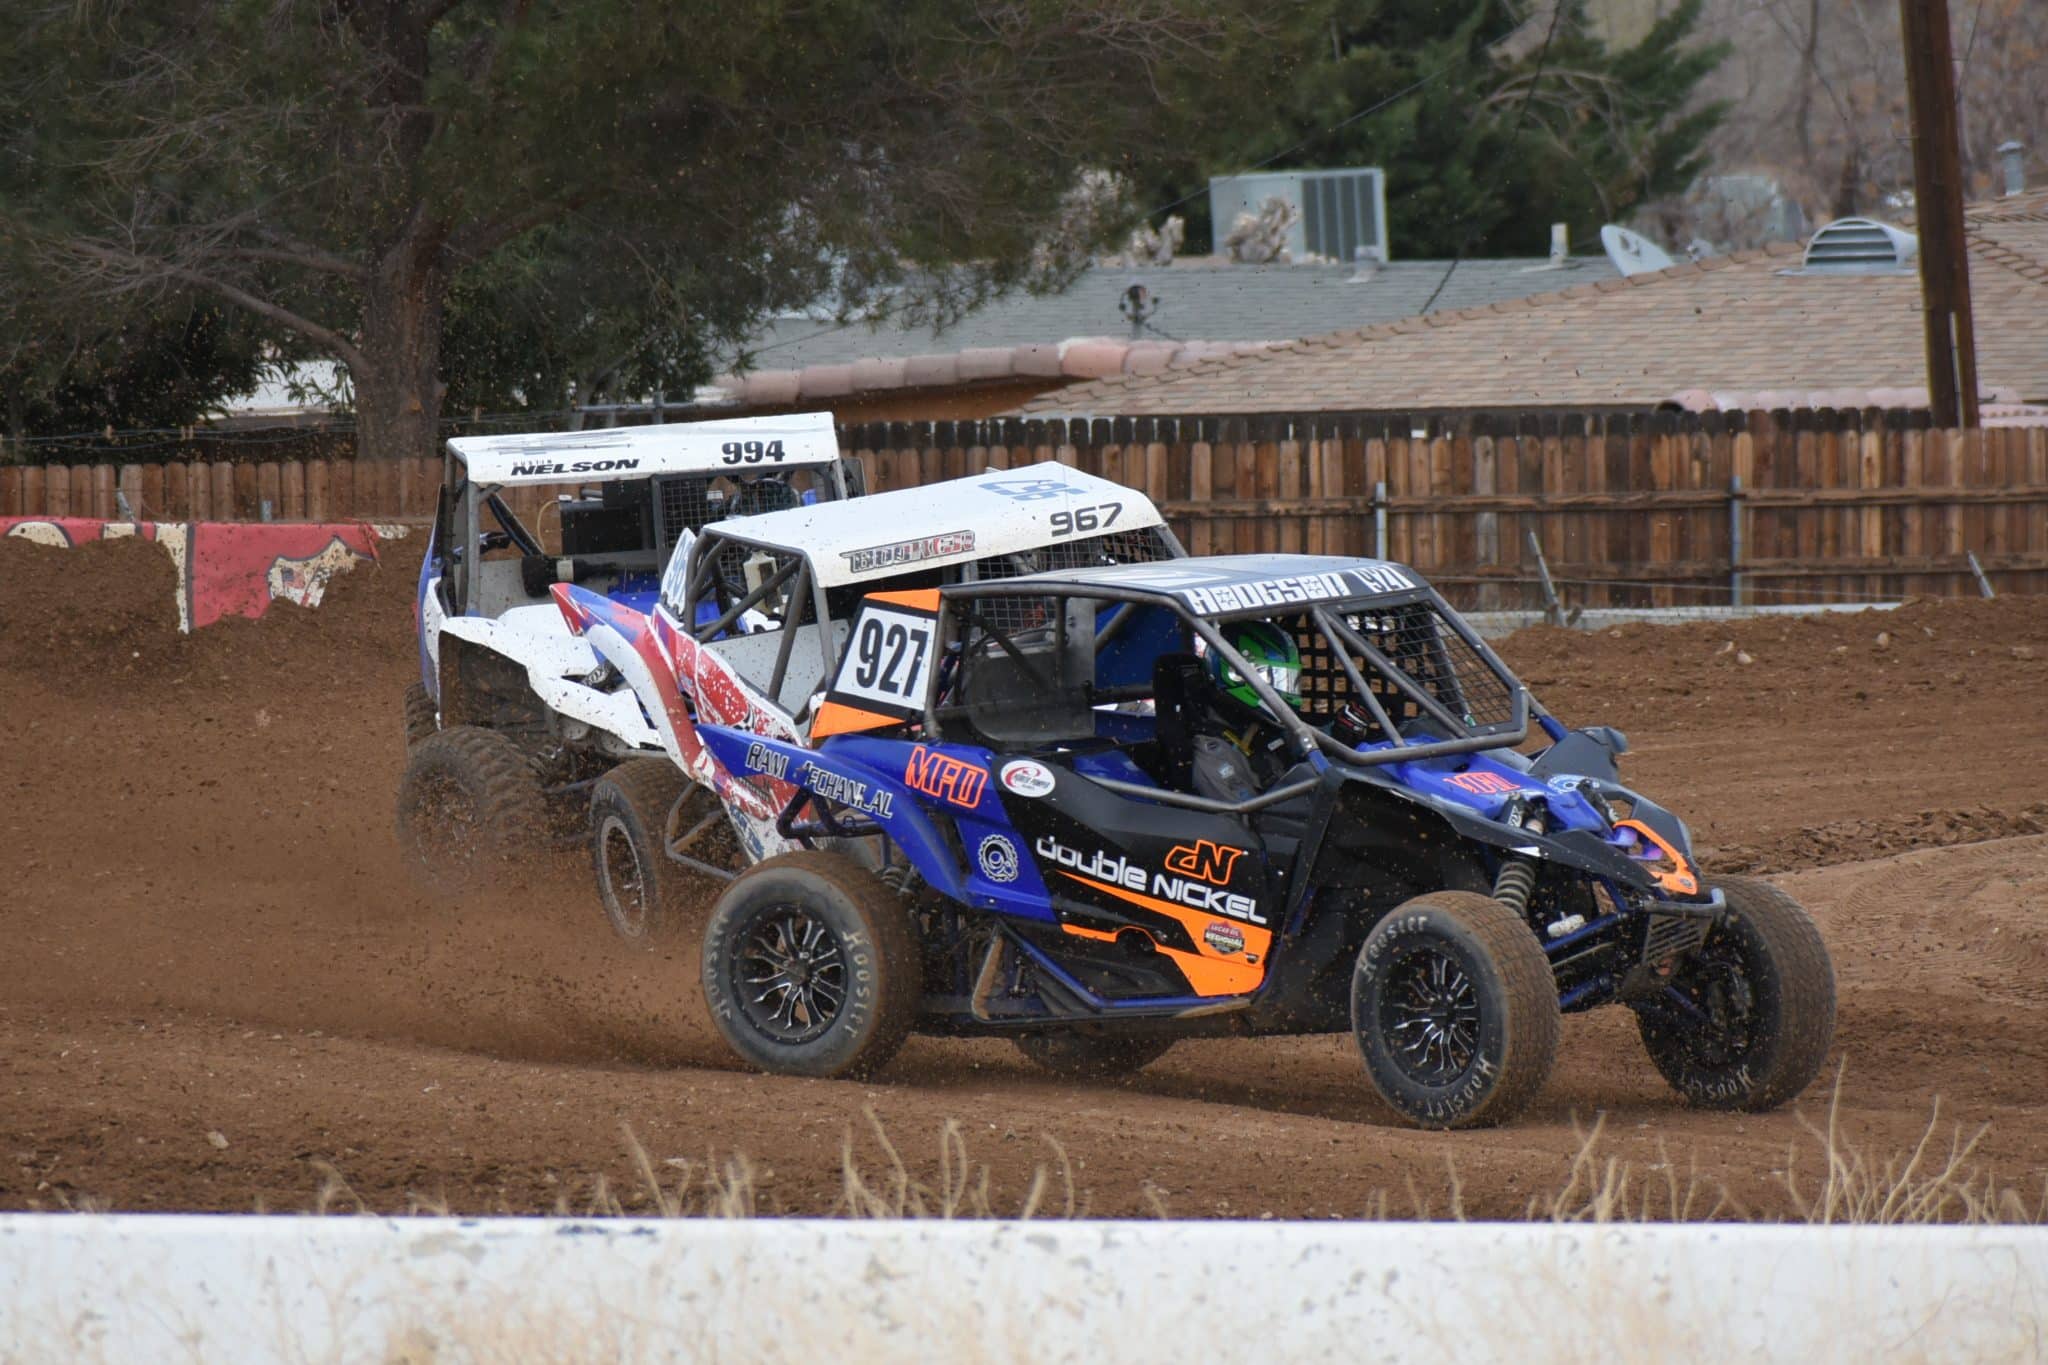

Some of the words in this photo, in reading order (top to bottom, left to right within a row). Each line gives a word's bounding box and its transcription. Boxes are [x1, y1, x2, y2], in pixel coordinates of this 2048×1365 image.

[511, 459, 640, 476] NELSON
[721, 440, 785, 465] 994
[1049, 502, 1123, 537] 967
[855, 618, 929, 697] 927
[745, 741, 790, 780] RAM
[1036, 835, 1148, 892] double
[1152, 872, 1268, 924] NICKEL
